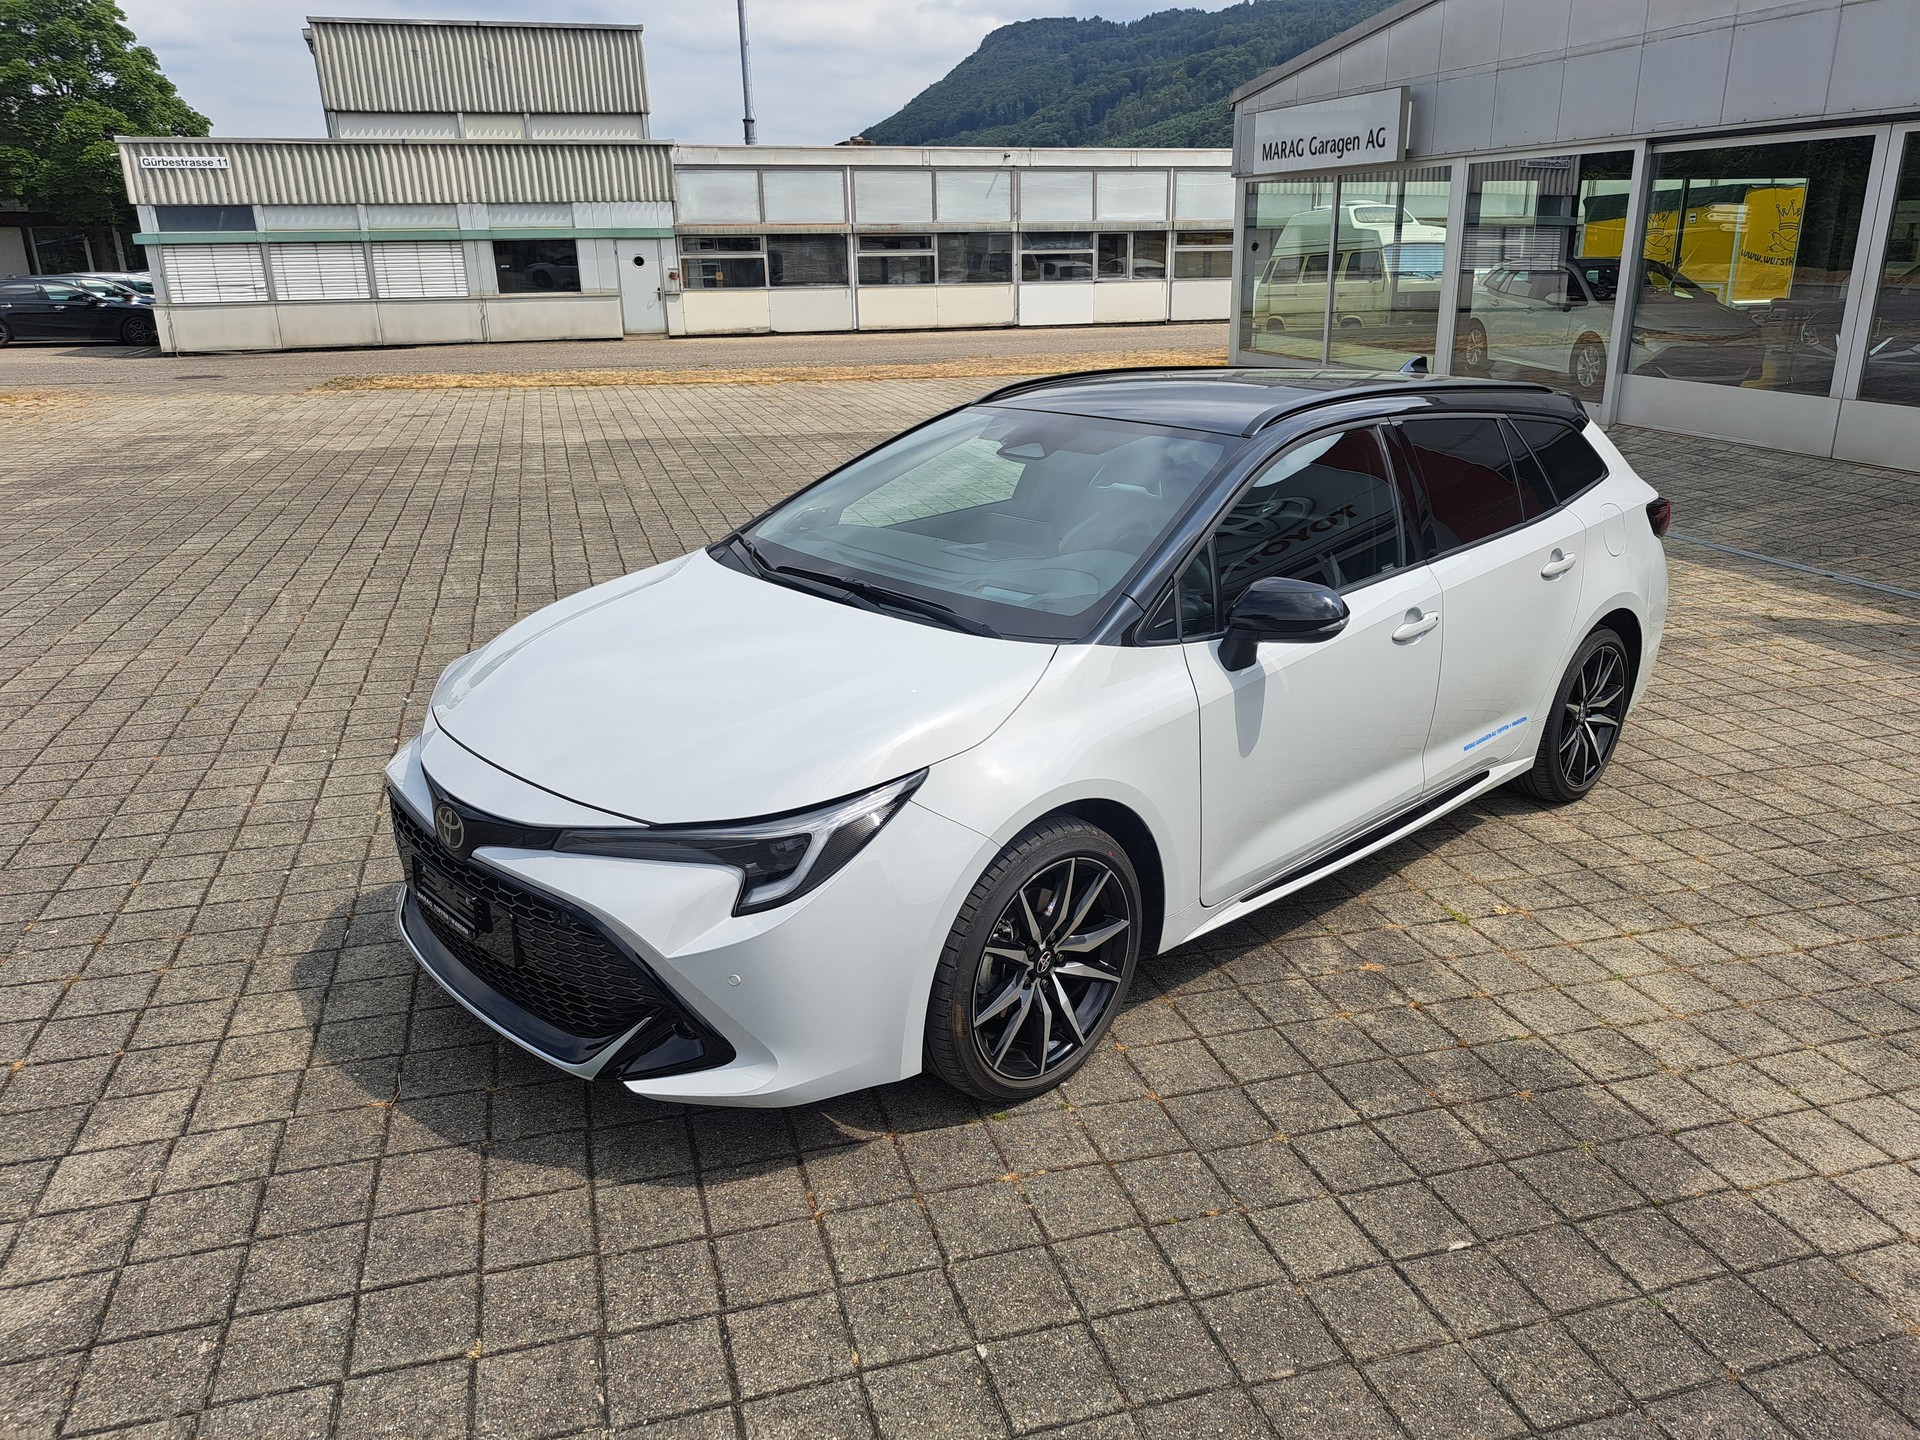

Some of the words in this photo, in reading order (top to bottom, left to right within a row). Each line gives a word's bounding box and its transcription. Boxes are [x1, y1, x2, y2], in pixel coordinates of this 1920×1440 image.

[1262, 138, 1304, 162] MARAG
[1308, 135, 1360, 159] Garagen
[1365, 126, 1386, 150] AG
[142, 157, 214, 167] Gürbestrasse
[217, 158, 229, 167] 11
